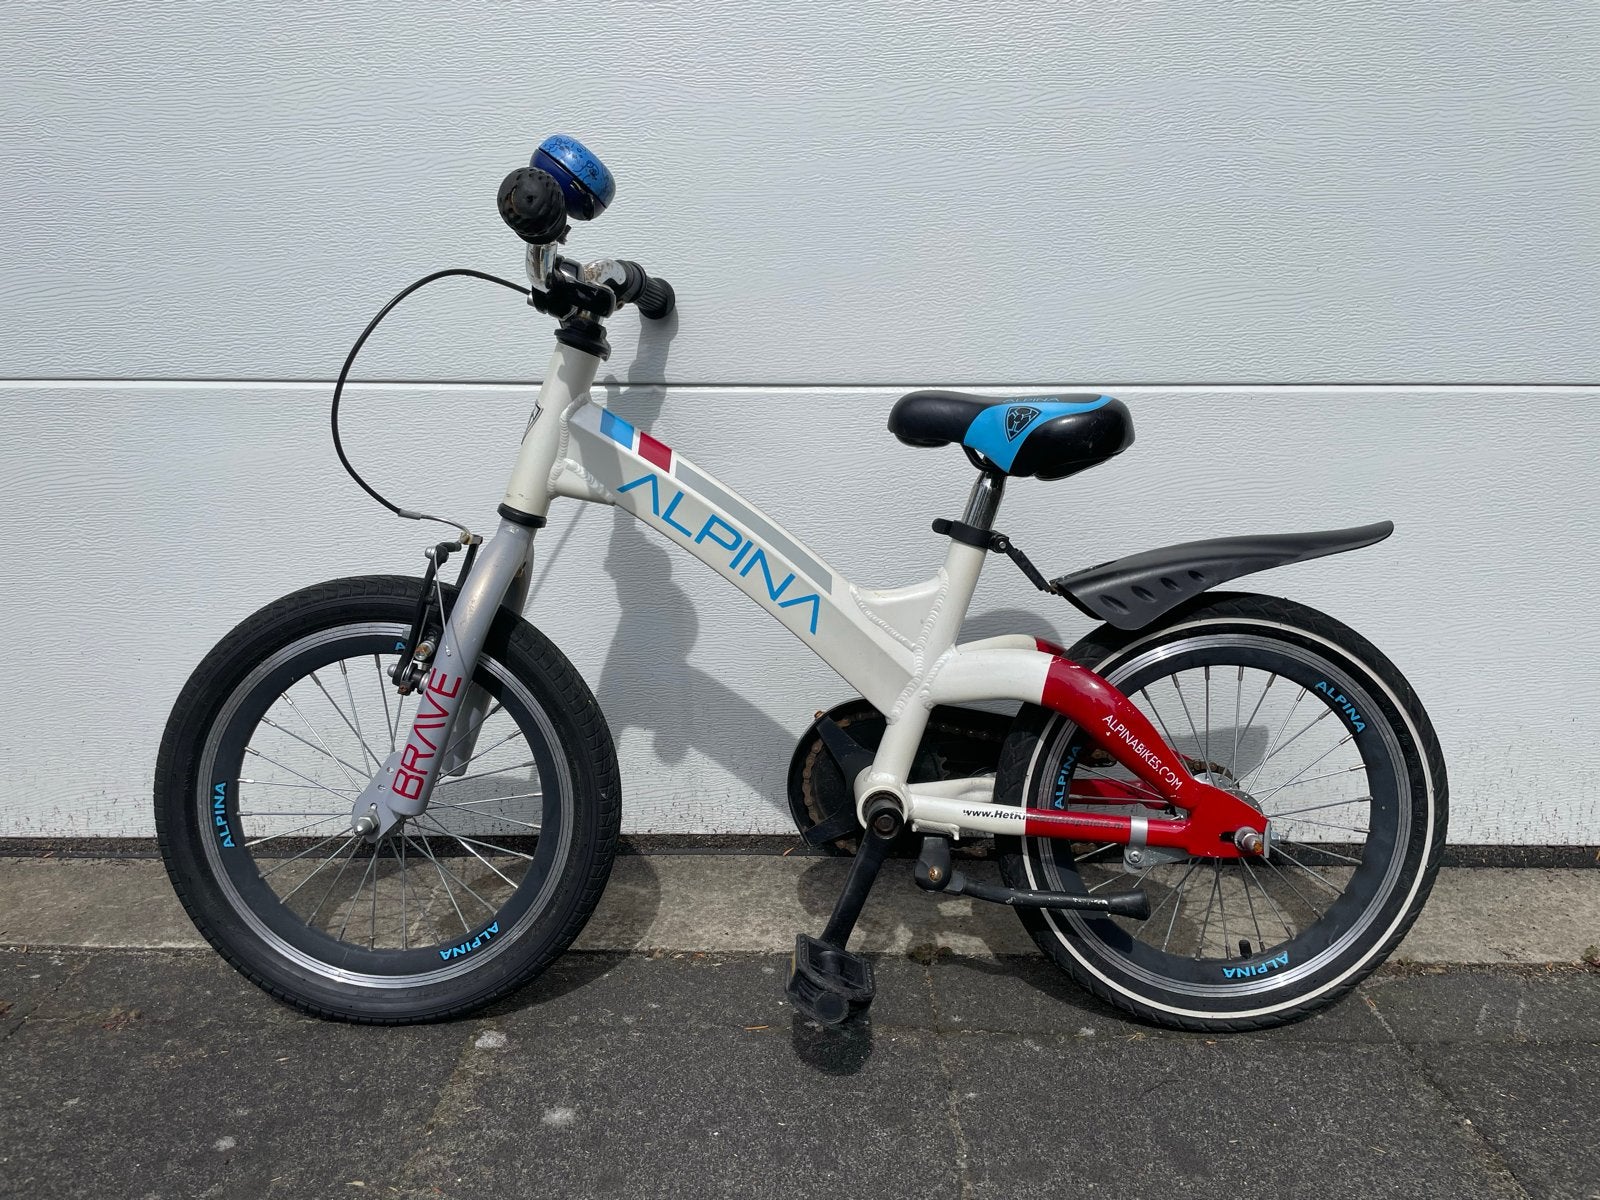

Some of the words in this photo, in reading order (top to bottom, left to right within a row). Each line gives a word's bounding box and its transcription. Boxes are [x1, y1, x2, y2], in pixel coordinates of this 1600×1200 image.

[616, 473, 821, 636] ALPINA
[391, 667, 463, 800] BRAVE
[1314, 681, 1366, 733] ALPINA
[1054, 746, 1082, 810] ALPINA
[1102, 714, 1183, 791] ALPINABIKES.COM
[213, 782, 236, 848] ALPINA
[440, 921, 499, 961] ALPINA
[1222, 950, 1289, 978] ALPINA
